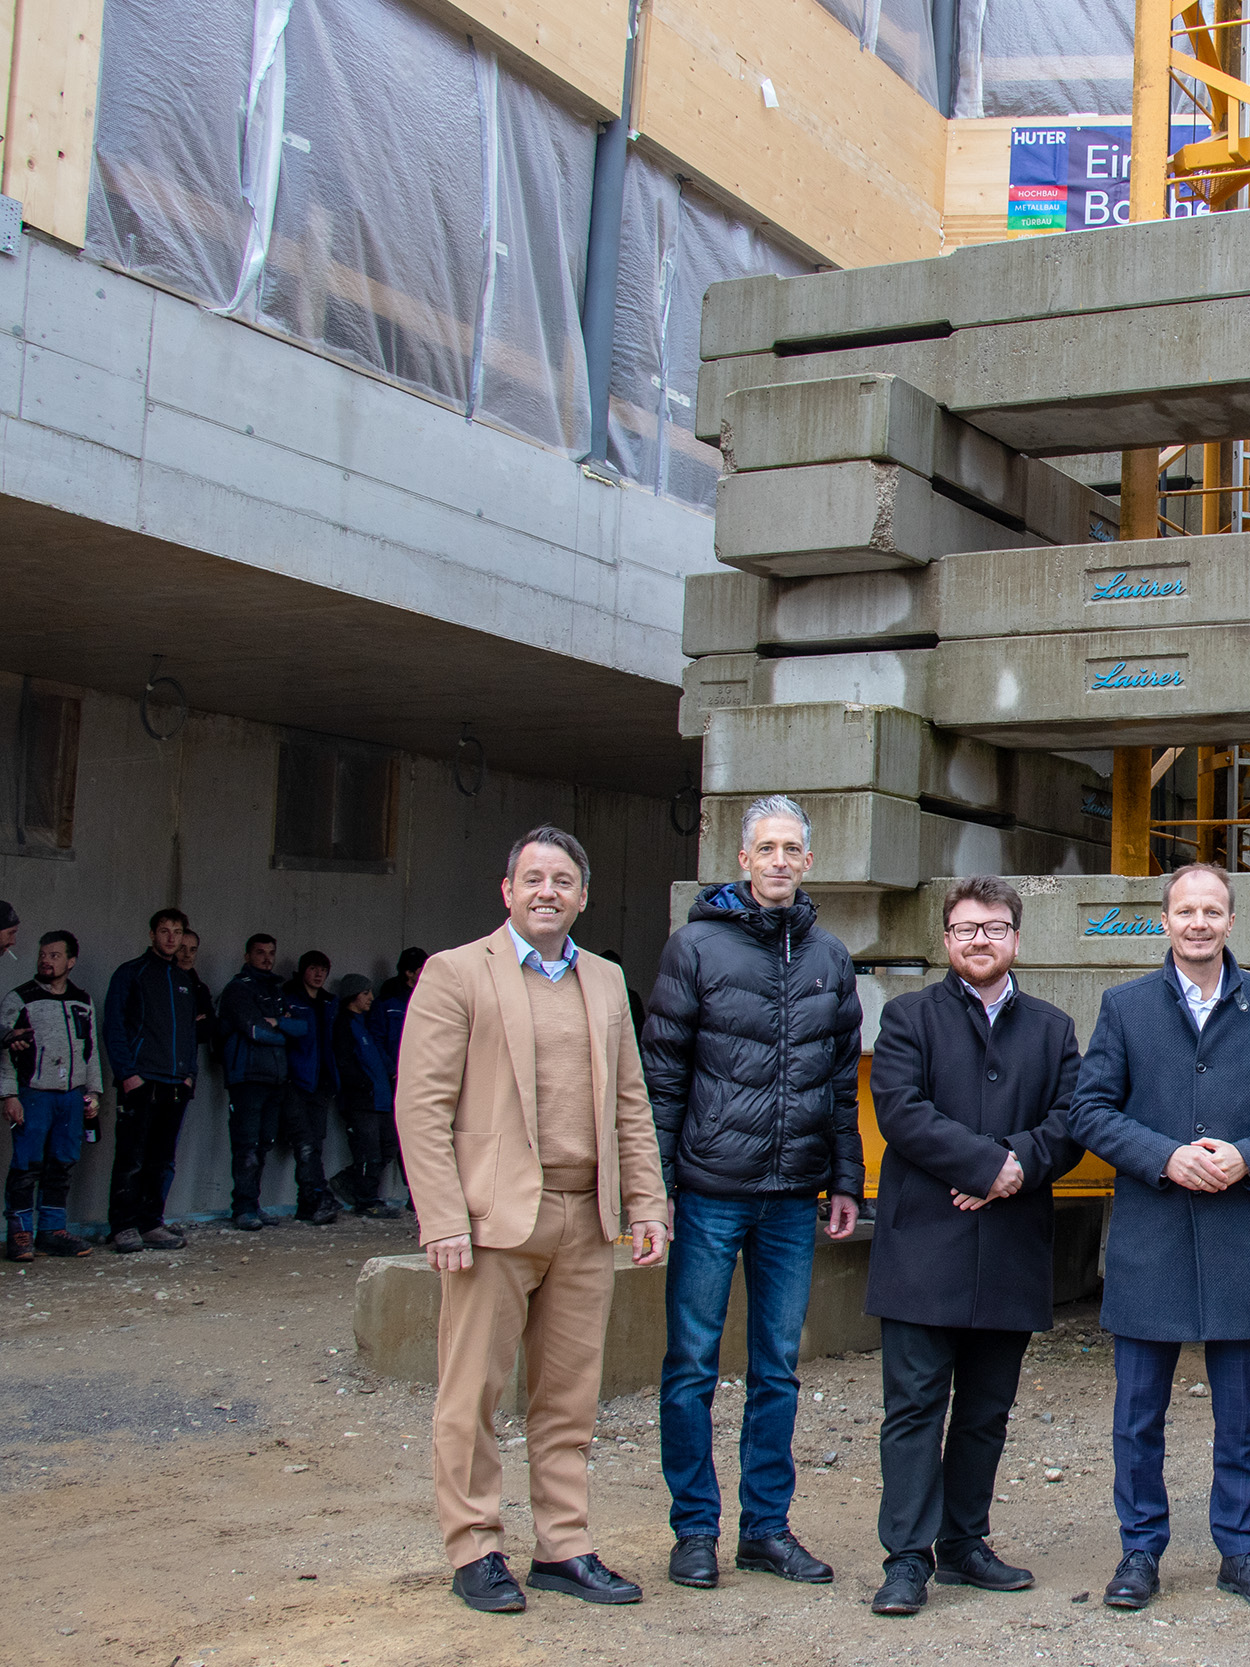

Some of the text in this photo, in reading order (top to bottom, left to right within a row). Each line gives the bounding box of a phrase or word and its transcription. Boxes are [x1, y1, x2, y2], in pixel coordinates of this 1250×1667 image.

[1014, 131, 1067, 145] HUTER
[1014, 204, 1060, 212] METALLBAU
[1021, 217, 1052, 226] TÜRBAU
